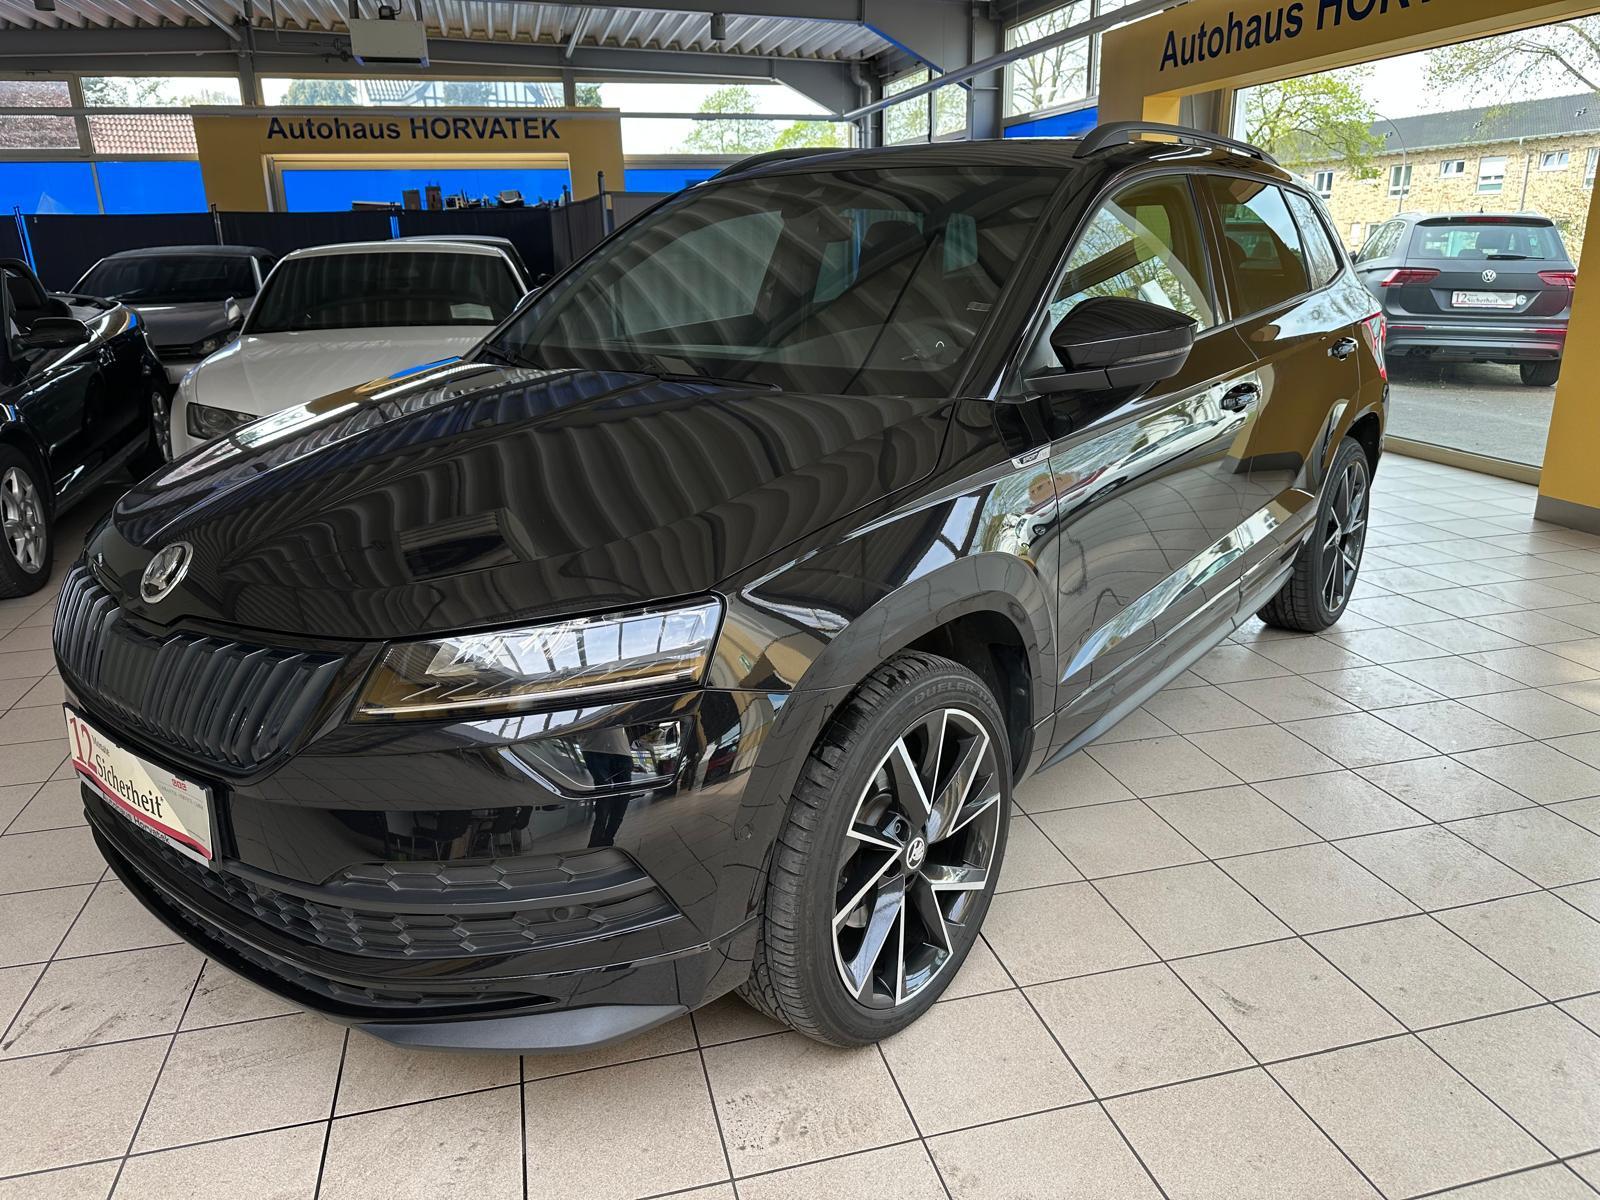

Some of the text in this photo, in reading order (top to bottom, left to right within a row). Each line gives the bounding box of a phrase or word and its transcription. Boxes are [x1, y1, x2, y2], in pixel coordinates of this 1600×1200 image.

[1159, 1, 1303, 71] Autohaus
[267, 117, 560, 140] Autohaus HORVATEK
[70, 717, 97, 774] 12
